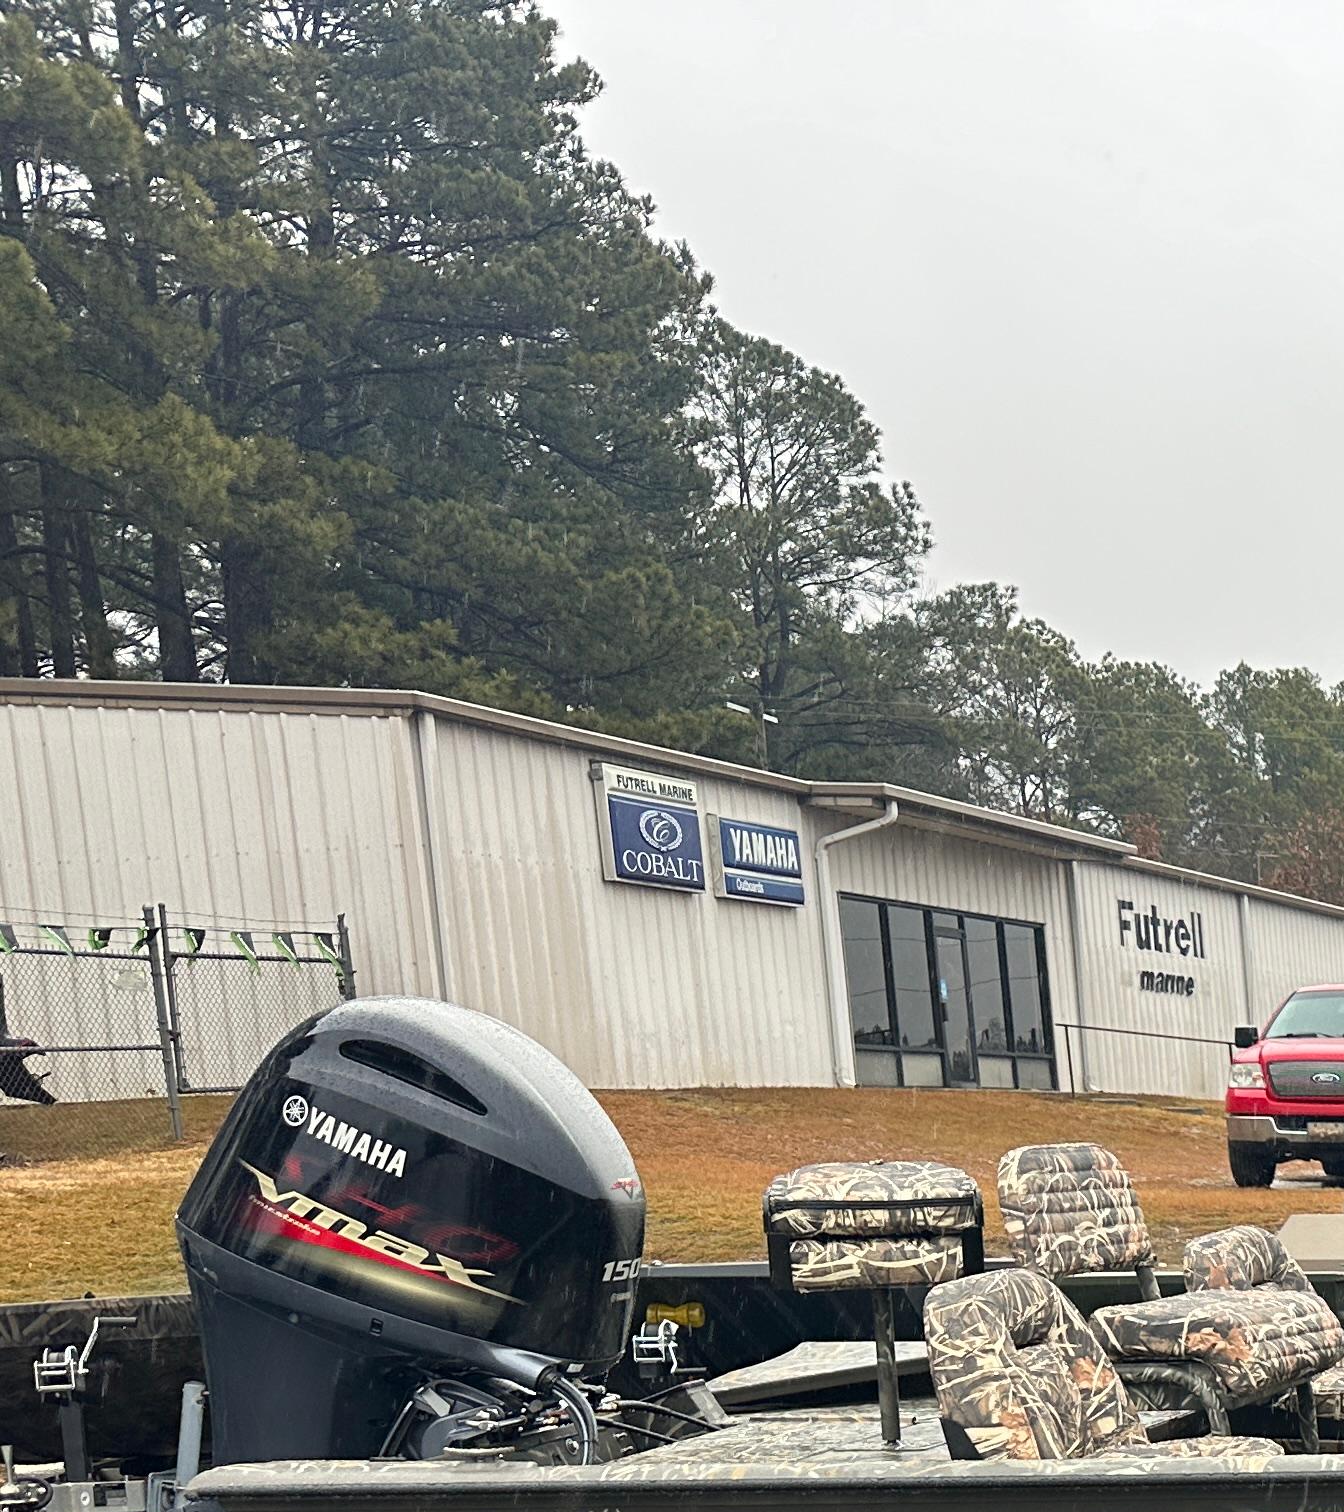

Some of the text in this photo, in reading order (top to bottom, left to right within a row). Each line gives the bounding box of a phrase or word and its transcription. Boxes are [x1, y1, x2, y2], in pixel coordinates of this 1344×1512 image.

[616, 774, 693, 801] FUTRELL MARINE
[622, 849, 702, 882] COBALT
[729, 827, 799, 871] YAMAHA
[1117, 899, 1205, 959] Futrell
[1139, 970, 1195, 997] marine
[306, 1106, 407, 1178] YAMAHA
[602, 1257, 641, 1282] 150
